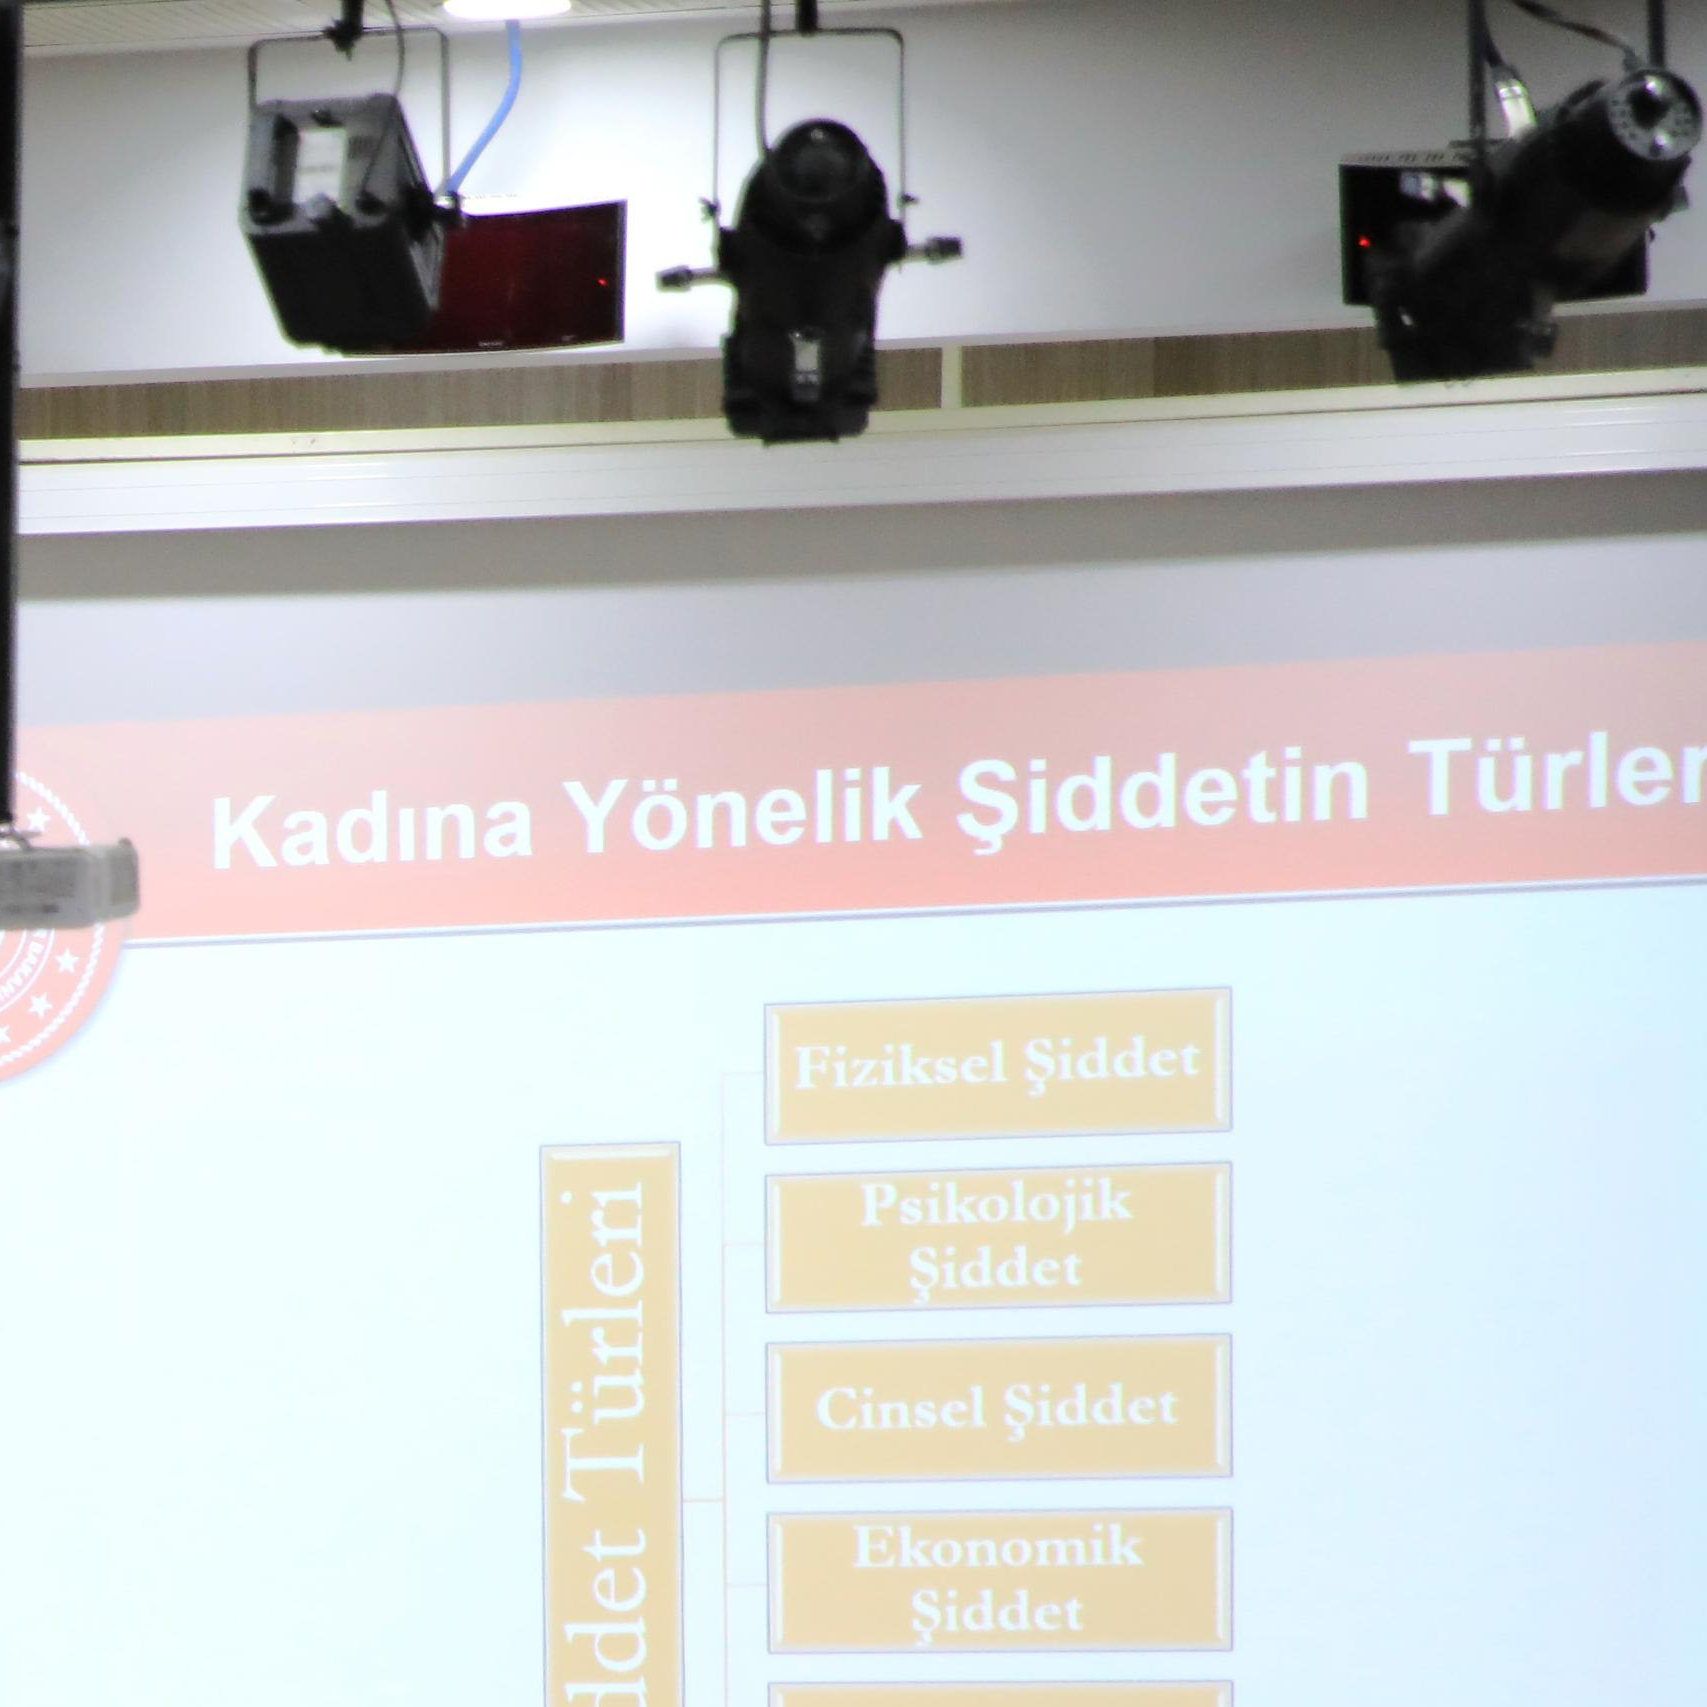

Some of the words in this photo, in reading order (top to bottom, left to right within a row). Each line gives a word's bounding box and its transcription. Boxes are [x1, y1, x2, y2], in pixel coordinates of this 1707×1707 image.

[212, 789, 534, 870] Kadına
[561, 766, 924, 854] Yönelik
[955, 745, 1369, 857] Şiddetin
[793, 1039, 1008, 1089] Fiziksel
[1022, 1034, 1202, 1097] Şiddet
[859, 1176, 1134, 1236] Psikolojik
[908, 1244, 1083, 1304] Şiddet
[558, 1179, 646, 1503] Türleri
[815, 1385, 987, 1432] Cinsel
[1003, 1381, 1179, 1443] Şiddet
[851, 1523, 1145, 1570] Ekonomik
[910, 1586, 1084, 1648] Şiddet
